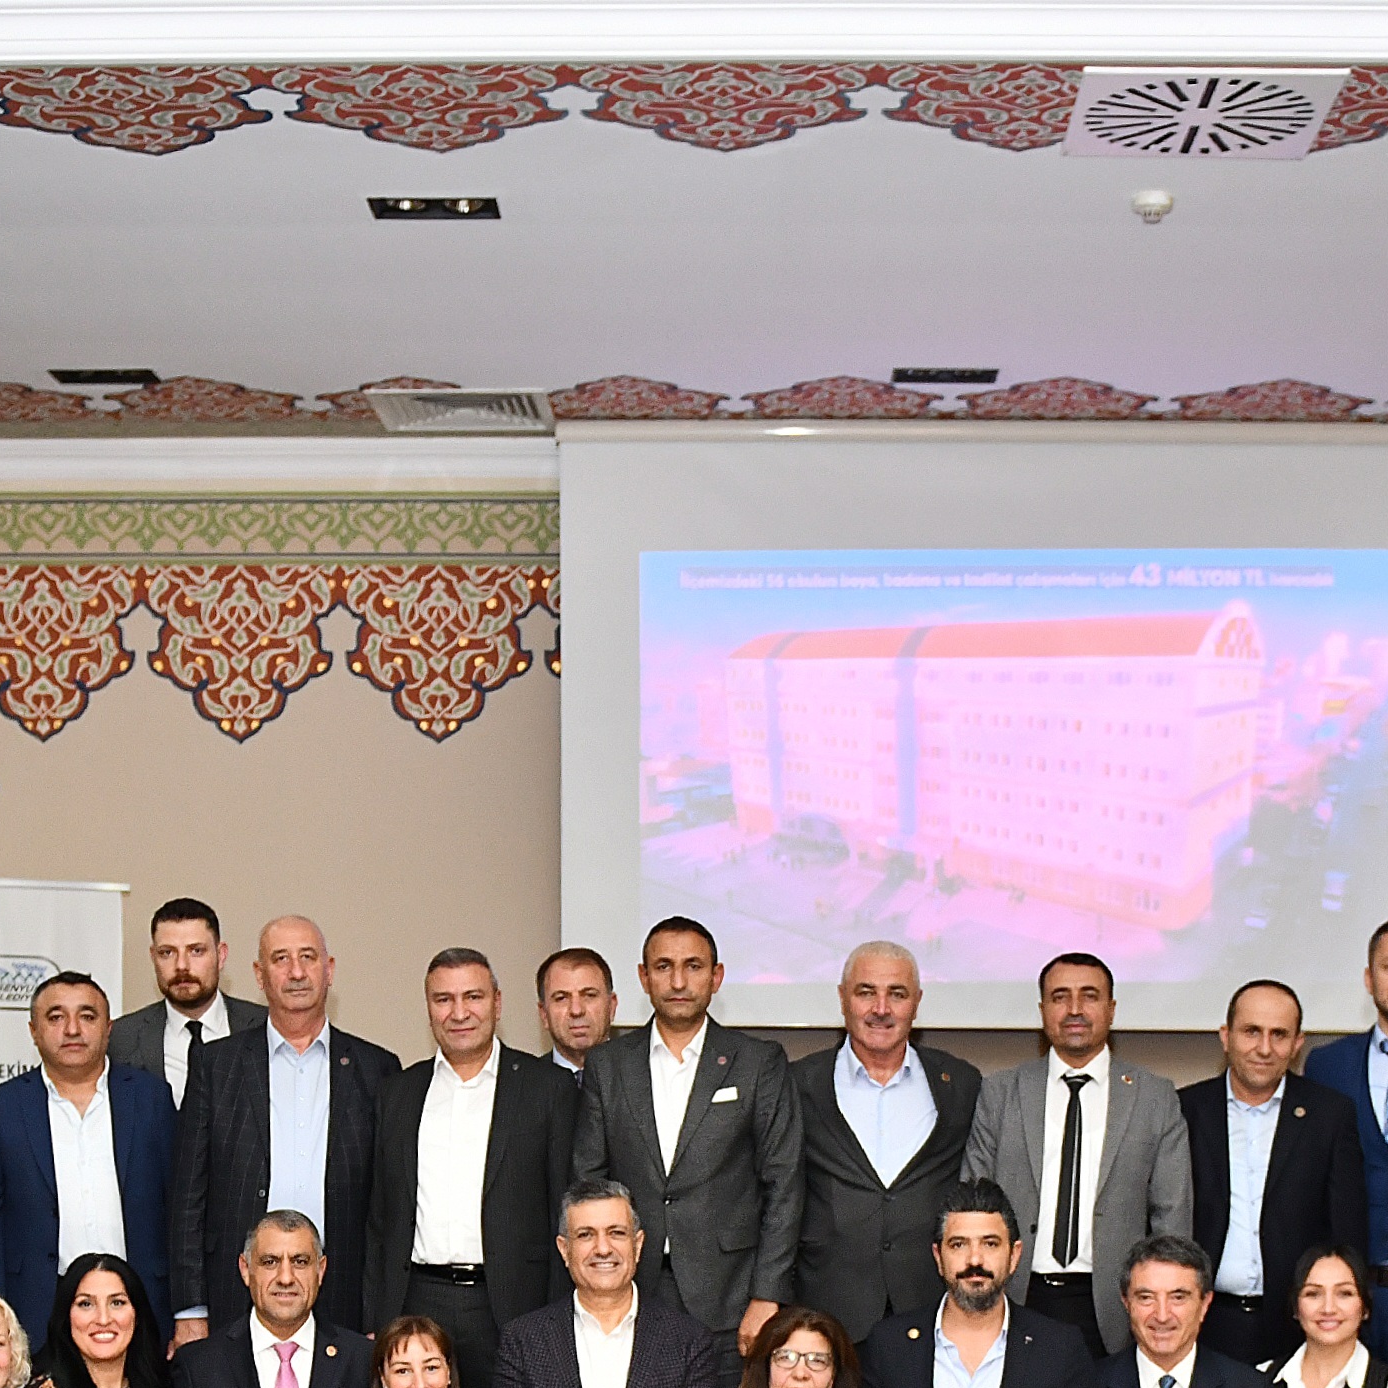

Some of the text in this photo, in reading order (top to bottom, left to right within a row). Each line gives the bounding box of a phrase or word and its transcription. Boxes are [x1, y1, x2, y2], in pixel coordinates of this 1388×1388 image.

[1128, 562, 1161, 588] 43
[1166, 566, 1242, 588] MİLYON
[1243, 568, 1266, 587] TL
